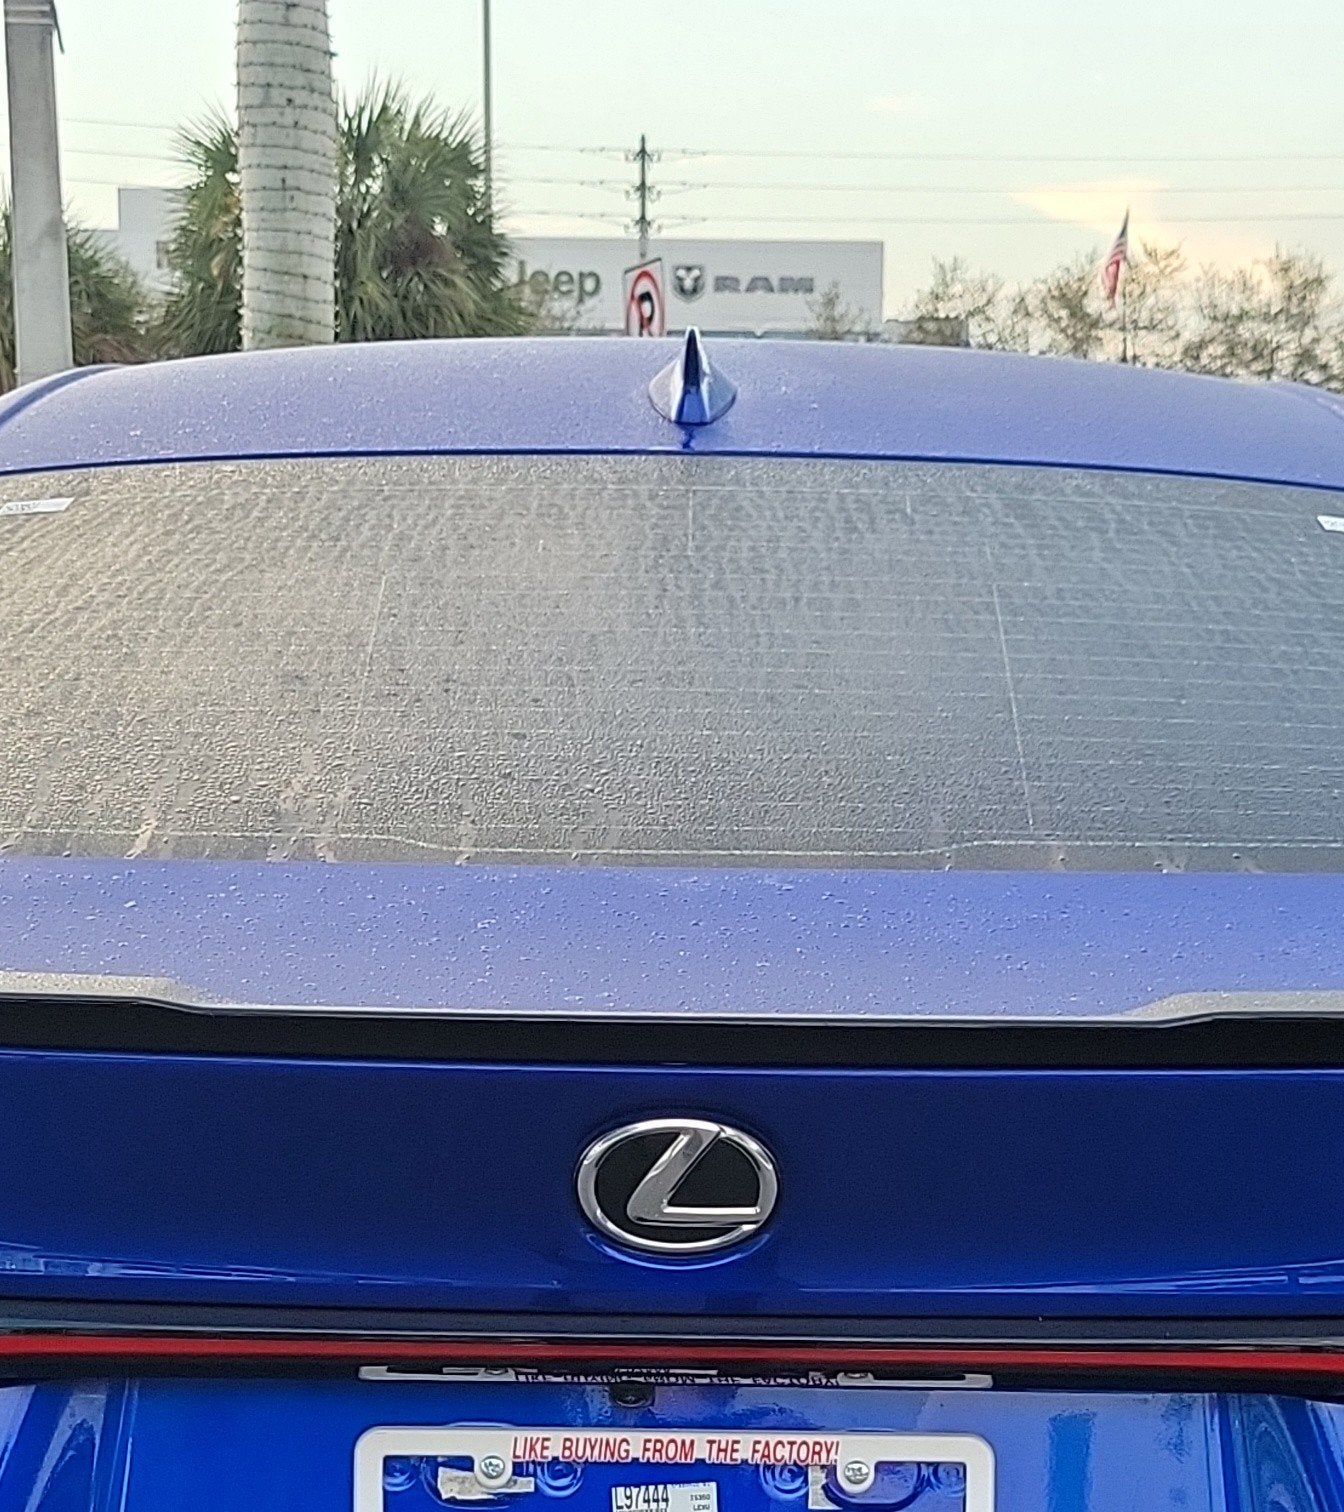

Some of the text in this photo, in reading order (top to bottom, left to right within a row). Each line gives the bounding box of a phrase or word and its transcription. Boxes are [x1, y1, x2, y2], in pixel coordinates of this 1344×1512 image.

[506, 259, 603, 304] Jeep
[713, 275, 815, 294] RAM
[512, 1436, 840, 1463] LIKE BUYING FROM THE FACTORY!
[616, 1485, 669, 1510] L97444
